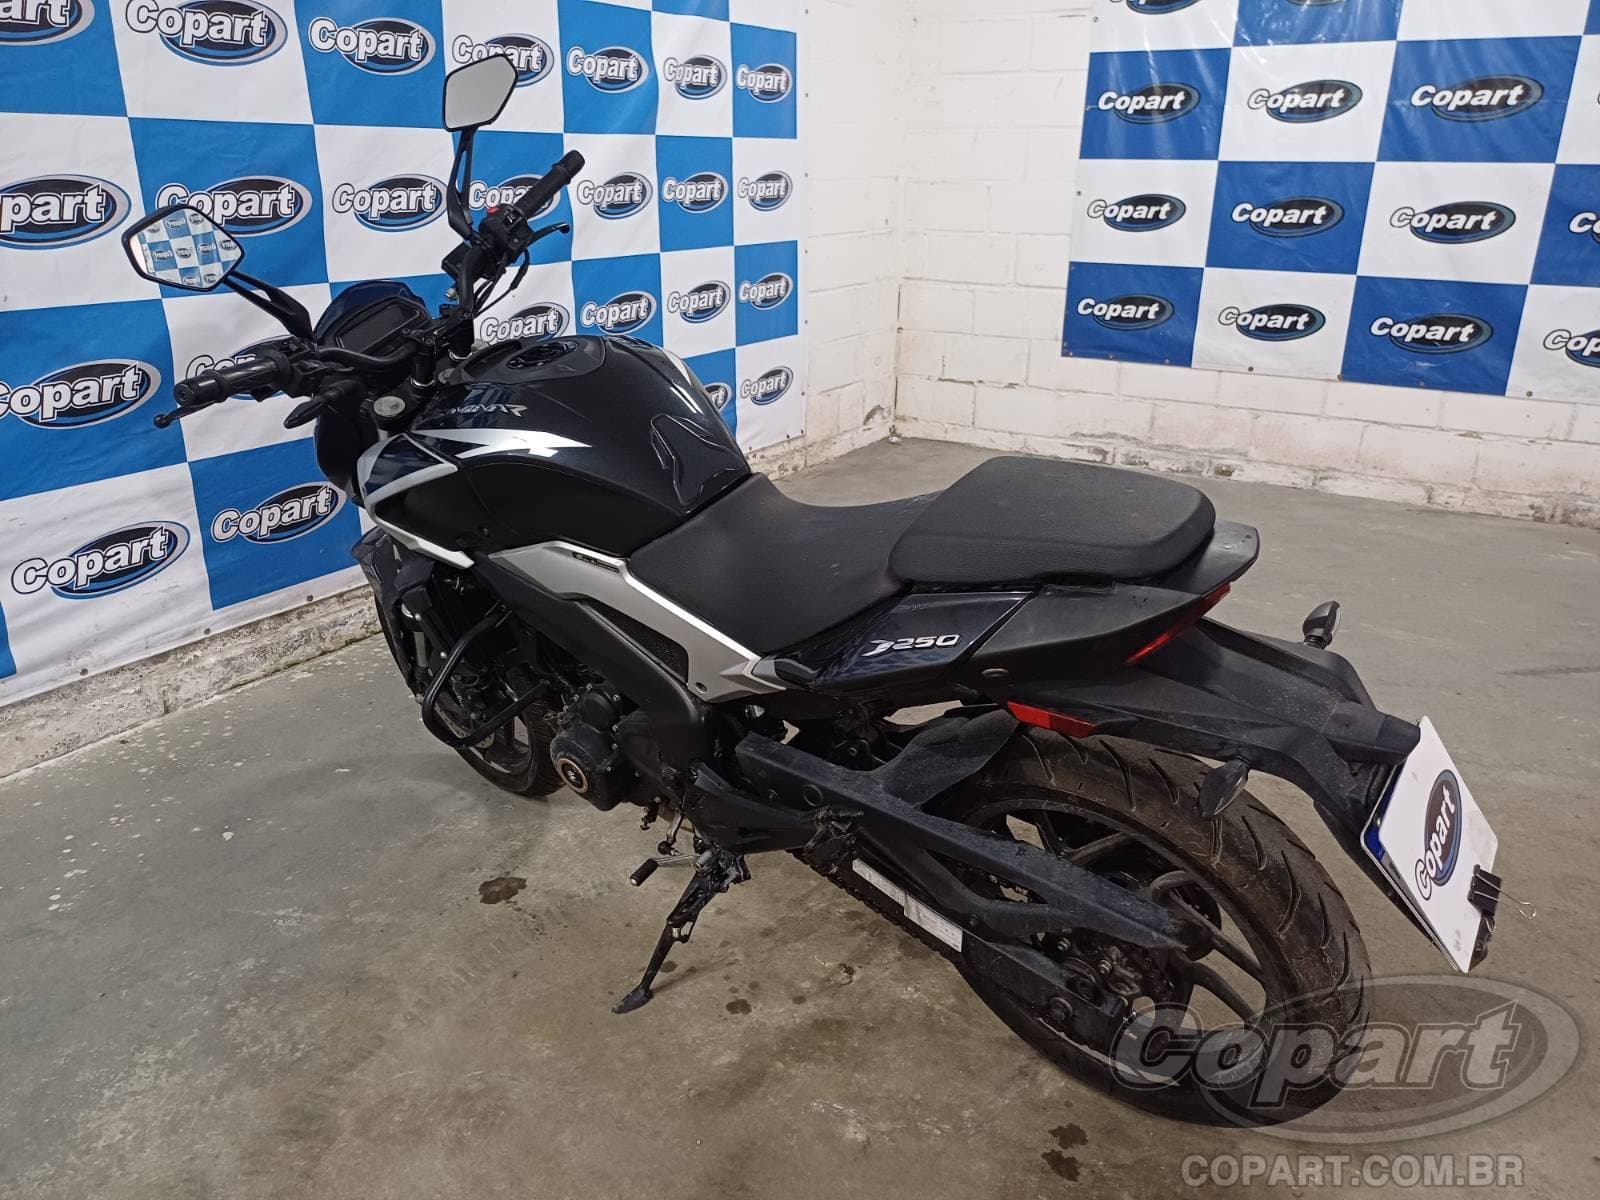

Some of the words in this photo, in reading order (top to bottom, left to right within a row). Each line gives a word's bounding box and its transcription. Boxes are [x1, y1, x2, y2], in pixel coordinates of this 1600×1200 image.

[126, 0, 268, 47] Copart
[309, 17, 424, 63] Copart
[567, 47, 638, 84] Copart
[664, 56, 718, 87] Copart
[736, 64, 787, 93] Copart
[1098, 90, 1185, 115] Copart
[1248, 88, 1345, 112] Copart
[1410, 84, 1524, 110] Copart
[332, 183, 436, 221] Copart
[577, 179, 641, 208] Copart
[663, 178, 720, 206] Copart
[737, 177, 787, 203] Copart
[1087, 199, 1171, 222] Copart
[1231, 203, 1327, 228] Copart
[1390, 207, 1497, 233] Copart
[667, 284, 723, 315] Copart
[739, 275, 787, 304] Copart
[481, 307, 559, 341] Copart
[581, 292, 649, 330] Copart
[1077, 298, 1160, 321] Copart
[1218, 307, 1309, 332] Copart
[1369, 318, 1474, 345] Copart
[740, 370, 787, 400] Copart
[212, 485, 333, 544] Copart
[11, 527, 169, 595] Copart
[1415, 784, 1456, 900] Copart
